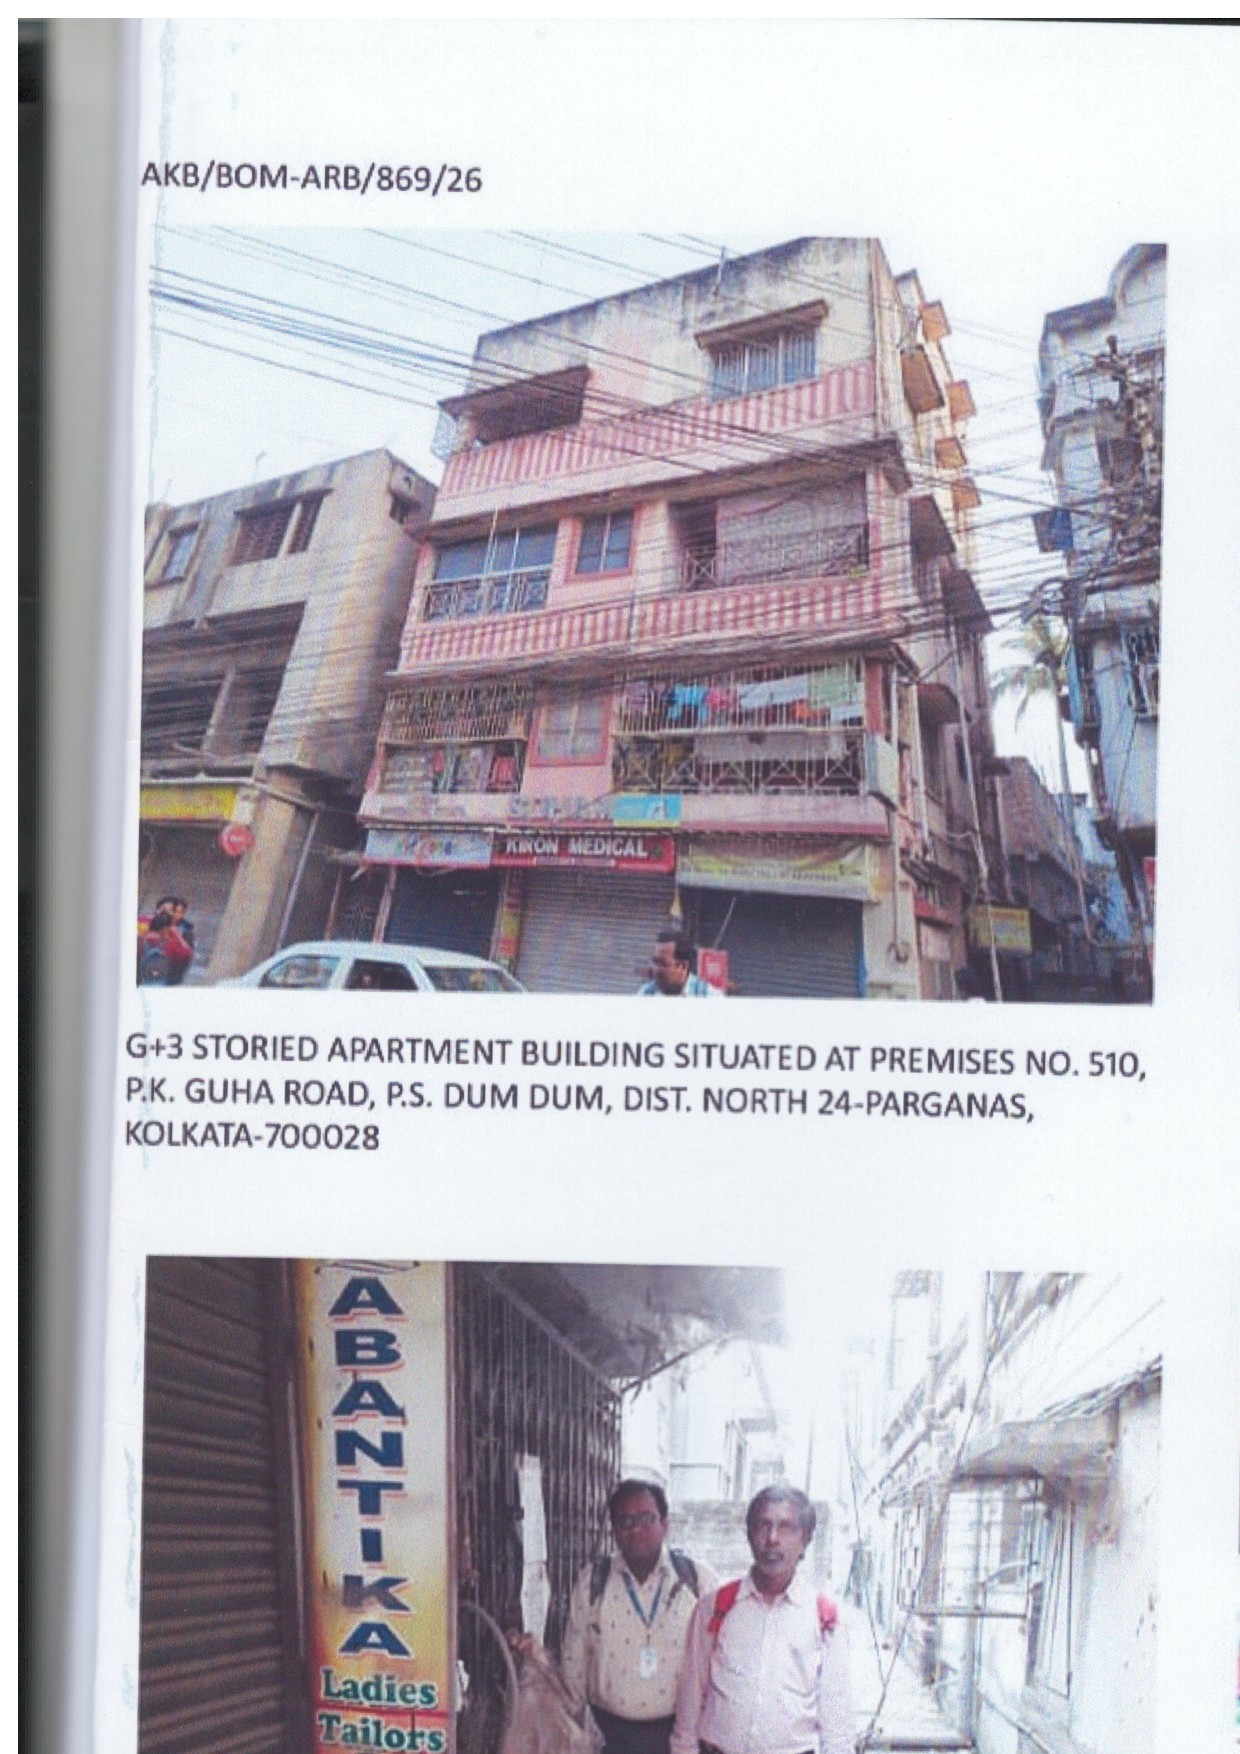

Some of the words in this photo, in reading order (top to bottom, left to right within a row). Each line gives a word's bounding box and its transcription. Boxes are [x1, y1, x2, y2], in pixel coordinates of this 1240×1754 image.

[141, 160, 482, 196] AKB/BOM-ARB/869/26
[569, 837, 648, 858] MEDICAL
[126, 1033, 183, 1059] G+3
[193, 1034, 318, 1062] STORIED
[327, 1037, 512, 1065] APARTMENT
[521, 1040, 664, 1068] BUILDING
[675, 1043, 817, 1071] SITUATED
[825, 1046, 861, 1071] AT
[871, 1047, 1015, 1075] PREMISES
[1026, 1050, 1078, 1076] NO.
[1090, 1051, 1146, 1081] 510,
[126, 1077, 174, 1102] P.K.
[185, 1077, 274, 1104] GUHA
[284, 1079, 375, 1110] ROAD,
[387, 1081, 432, 1108] P.S.
[445, 1083, 518, 1109] DUM
[530, 1084, 612, 1114] DUM,
[624, 1086, 691, 1112] DIST.
[703, 1087, 807, 1114] NORTH
[818, 1089, 1034, 1123] 24-PARGANAS,
[126, 1120, 379, 1150] KOLKATA-700028
[330, 1276, 411, 1659] ABANTIKA
[320, 1668, 438, 1709] Ladies
[317, 1712, 446, 1753] Tailors
